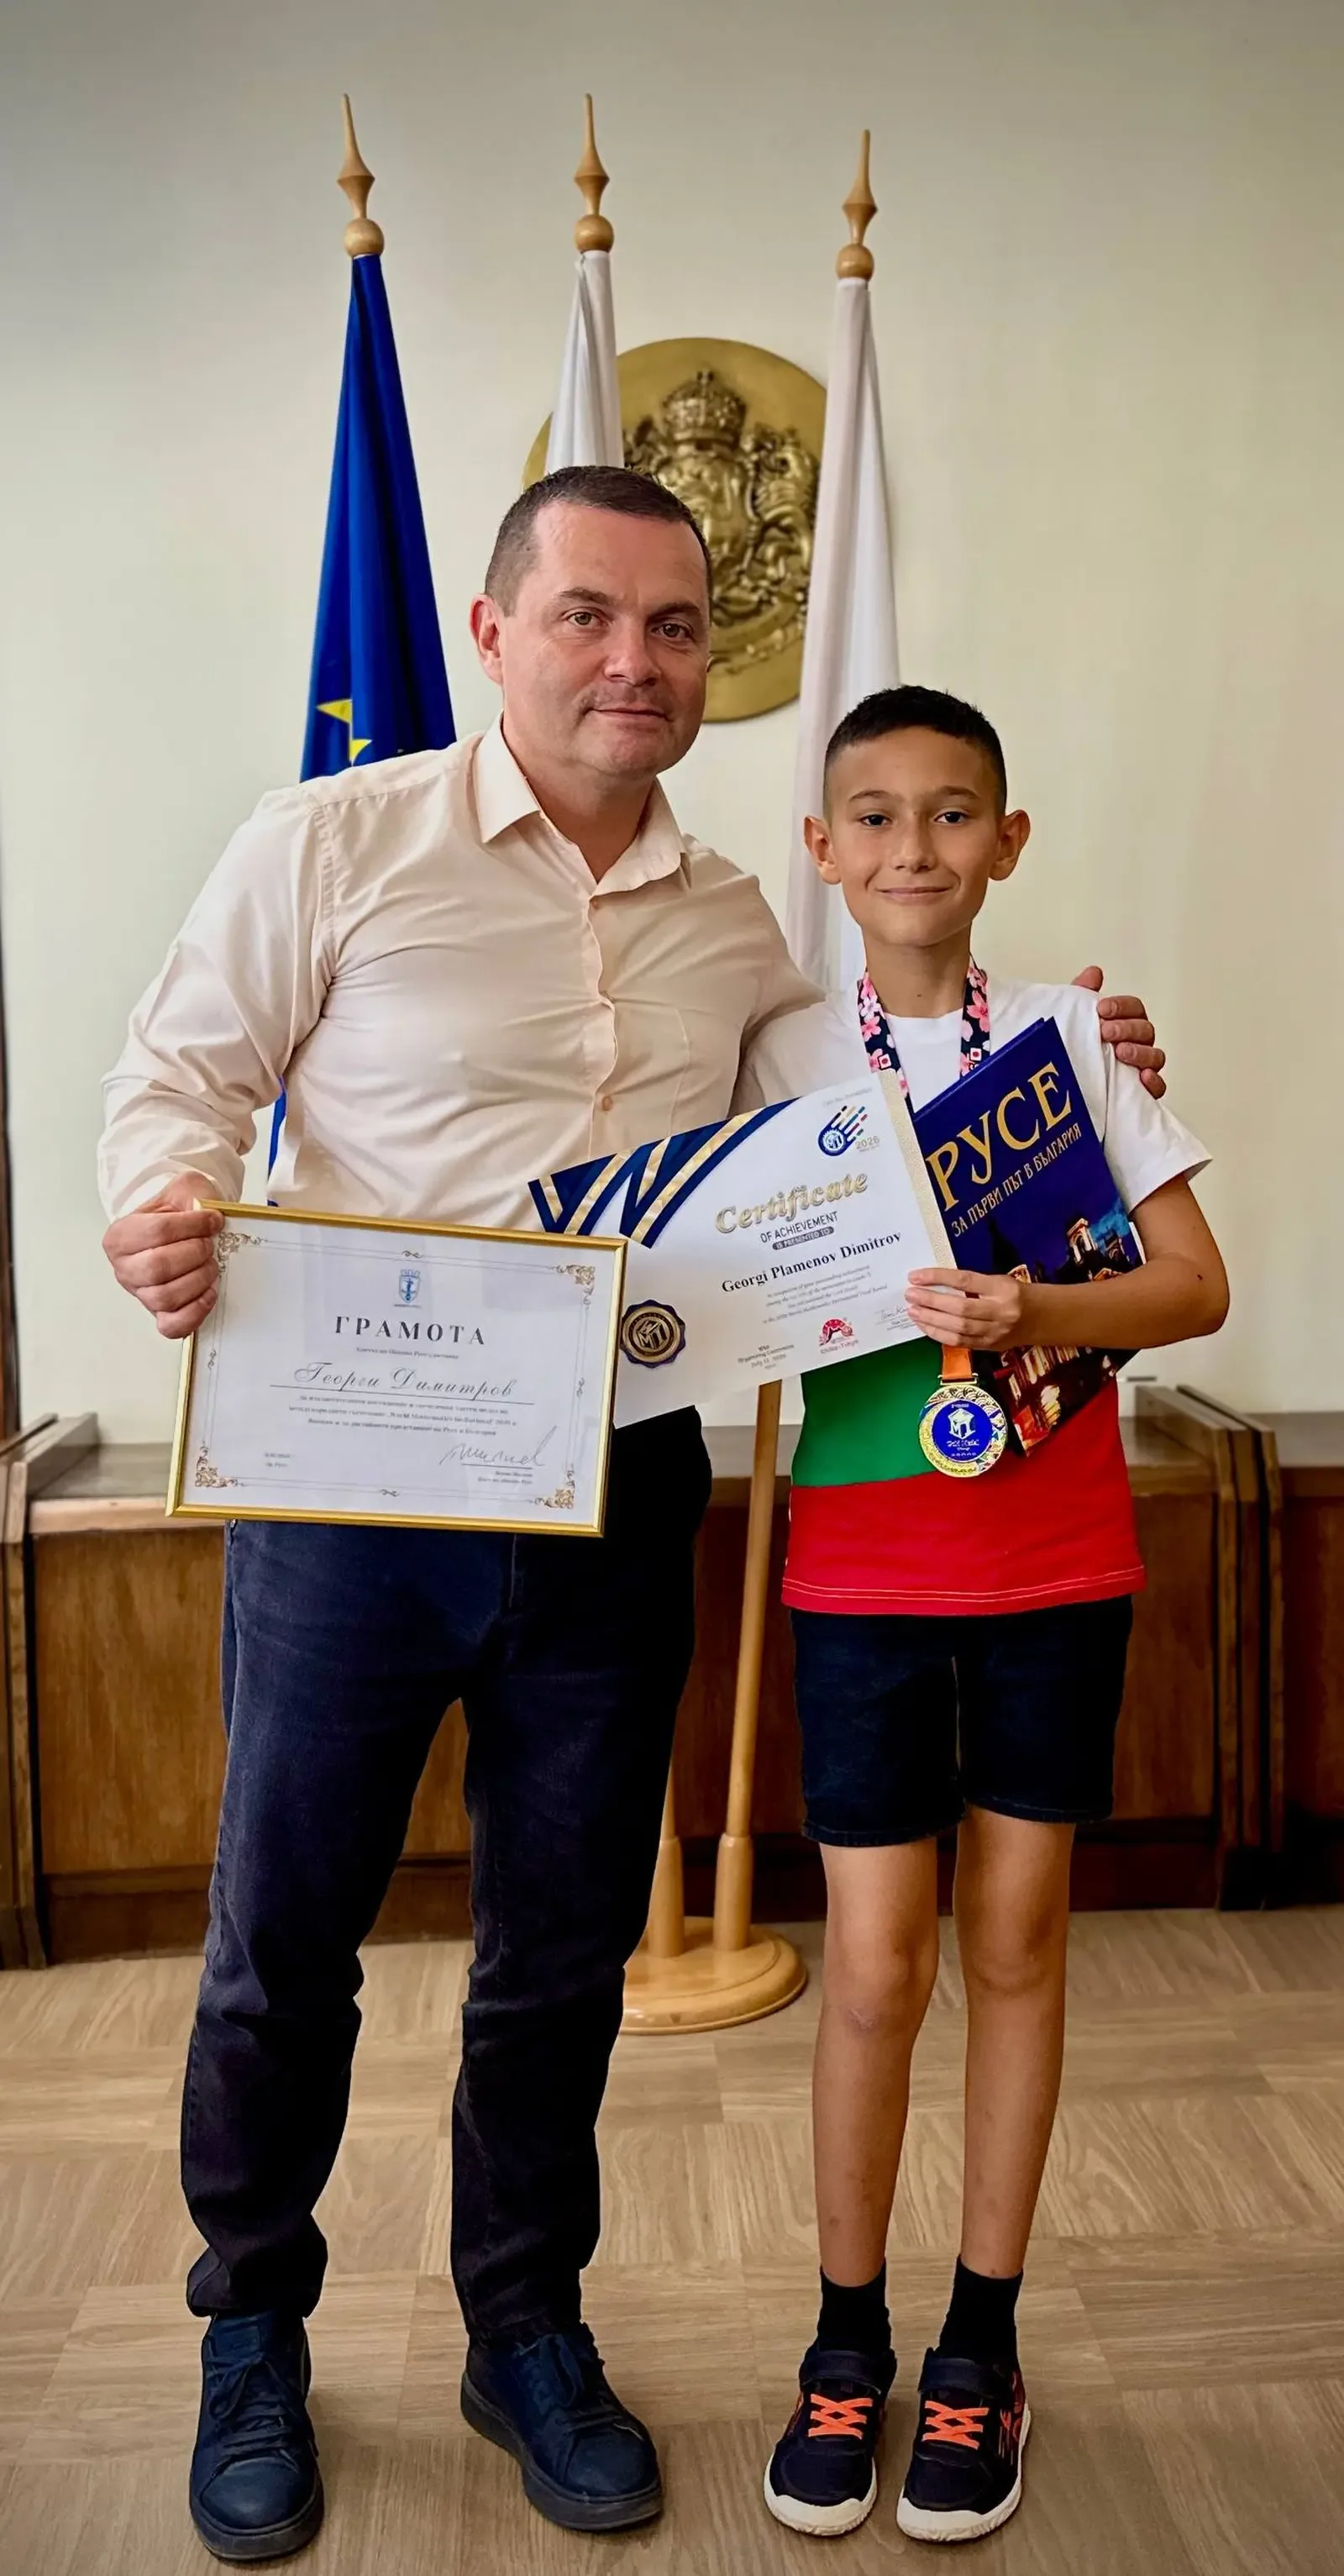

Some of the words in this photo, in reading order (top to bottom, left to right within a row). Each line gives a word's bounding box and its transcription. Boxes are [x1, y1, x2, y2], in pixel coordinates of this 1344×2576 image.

[925, 1061, 1072, 1212] РУСЕ
[715, 1173, 869, 1234] Certificate
[952, 1217, 969, 1238] ЗА
[968, 1187, 1004, 1225] ПЪРВИ
[1002, 1170, 1025, 1197] ПЪТ
[1023, 1163, 1034, 1180] В
[1033, 1122, 1083, 1172] БЪЛГАРИЯ
[760, 1231, 773, 1243] OF
[774, 1211, 838, 1239] ACHIEVEMENT
[722, 1270, 769, 1293] Georgi
[770, 1252, 837, 1280] Plamenov
[840, 1232, 901, 1259] Dimitrov
[335, 1316, 485, 1345] ГРАМОТА
[294, 1361, 380, 1391] Георги
[390, 1367, 518, 1401] Димитров
